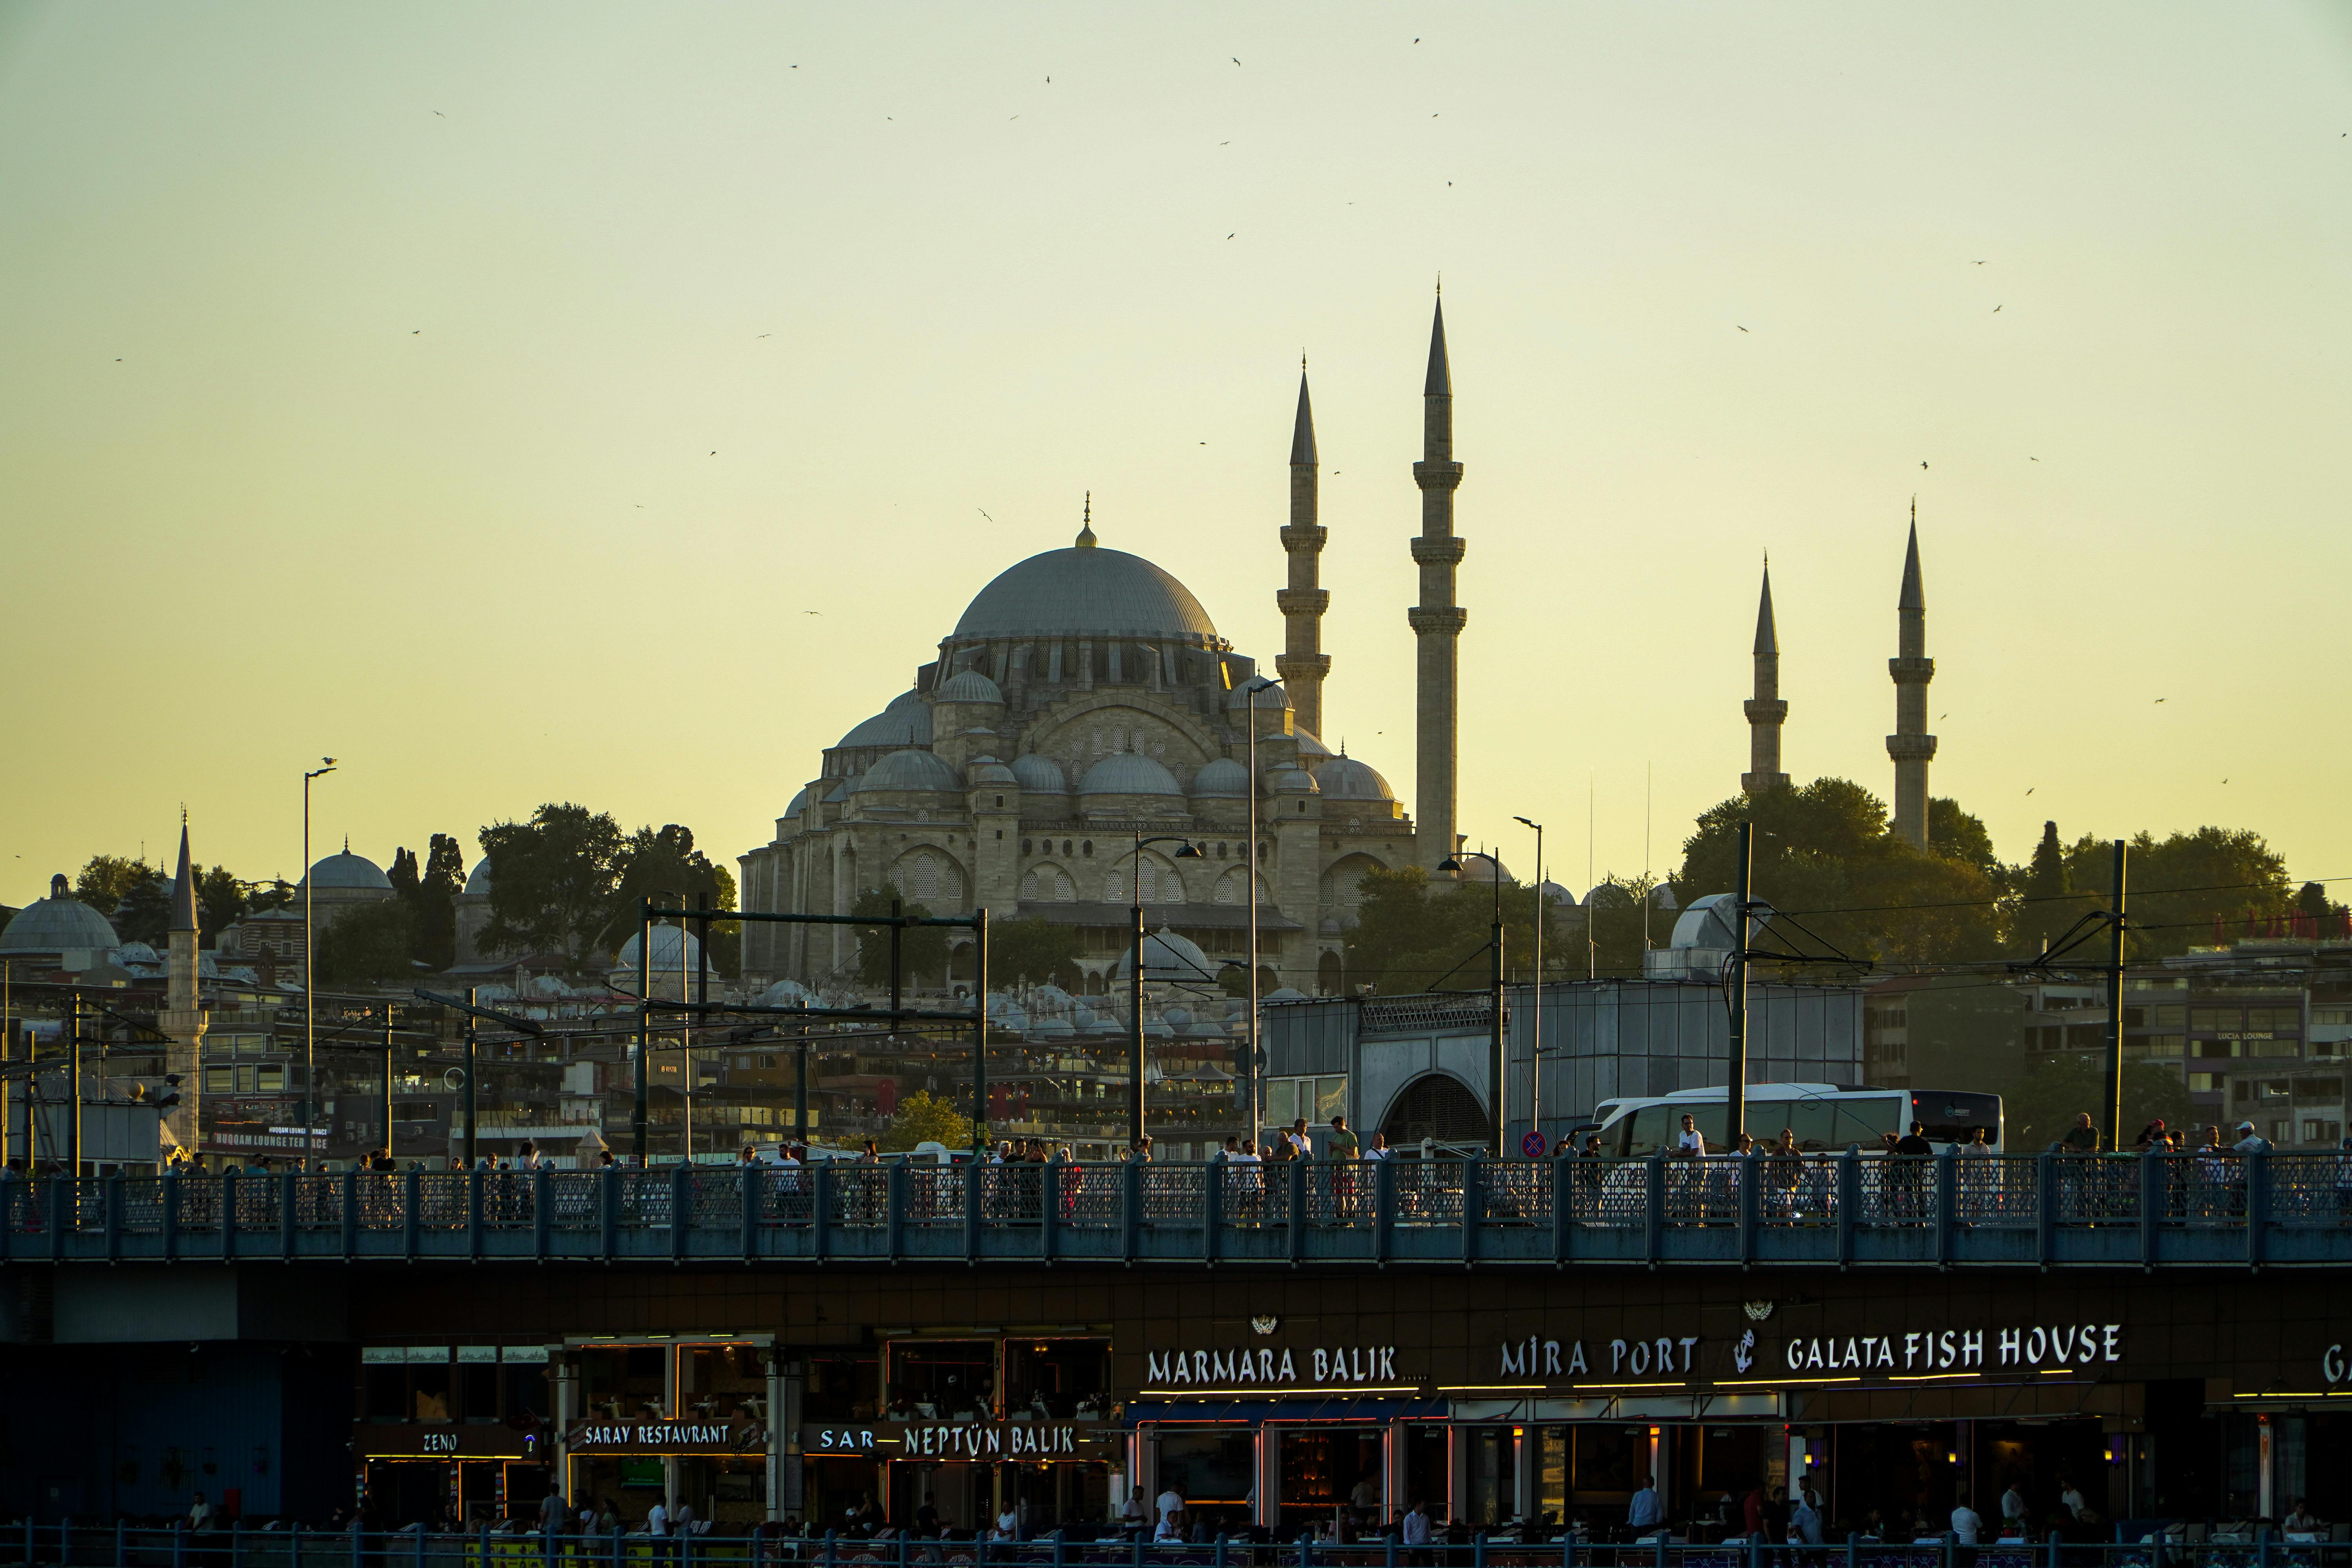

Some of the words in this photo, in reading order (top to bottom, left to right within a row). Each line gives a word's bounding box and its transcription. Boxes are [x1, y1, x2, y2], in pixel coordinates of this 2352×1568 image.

[216, 1133, 252, 1145] HUQQAM
[254, 1135, 287, 1147] LOUNGE
[289, 1137, 327, 1149] TERACE
[1501, 1334, 1588, 1377] MİRA
[1610, 1337, 1698, 1375] PORT
[1788, 1336, 1894, 1369] GALATA
[1905, 1329, 1983, 1370] FISH
[1999, 1325, 2121, 1365] HOUSE
[2324, 1345, 2352, 1383] G
[1149, 1348, 1296, 1384] MARMARA
[1313, 1346, 1396, 1381] BALIK
[424, 1434, 456, 1451] ZENO
[585, 1426, 631, 1444] SARAY
[638, 1425, 729, 1444] RESTAURANT
[820, 1430, 873, 1448] SAR
[905, 1423, 1000, 1457] NEPTÜN
[1011, 1426, 1074, 1454] BALIK
